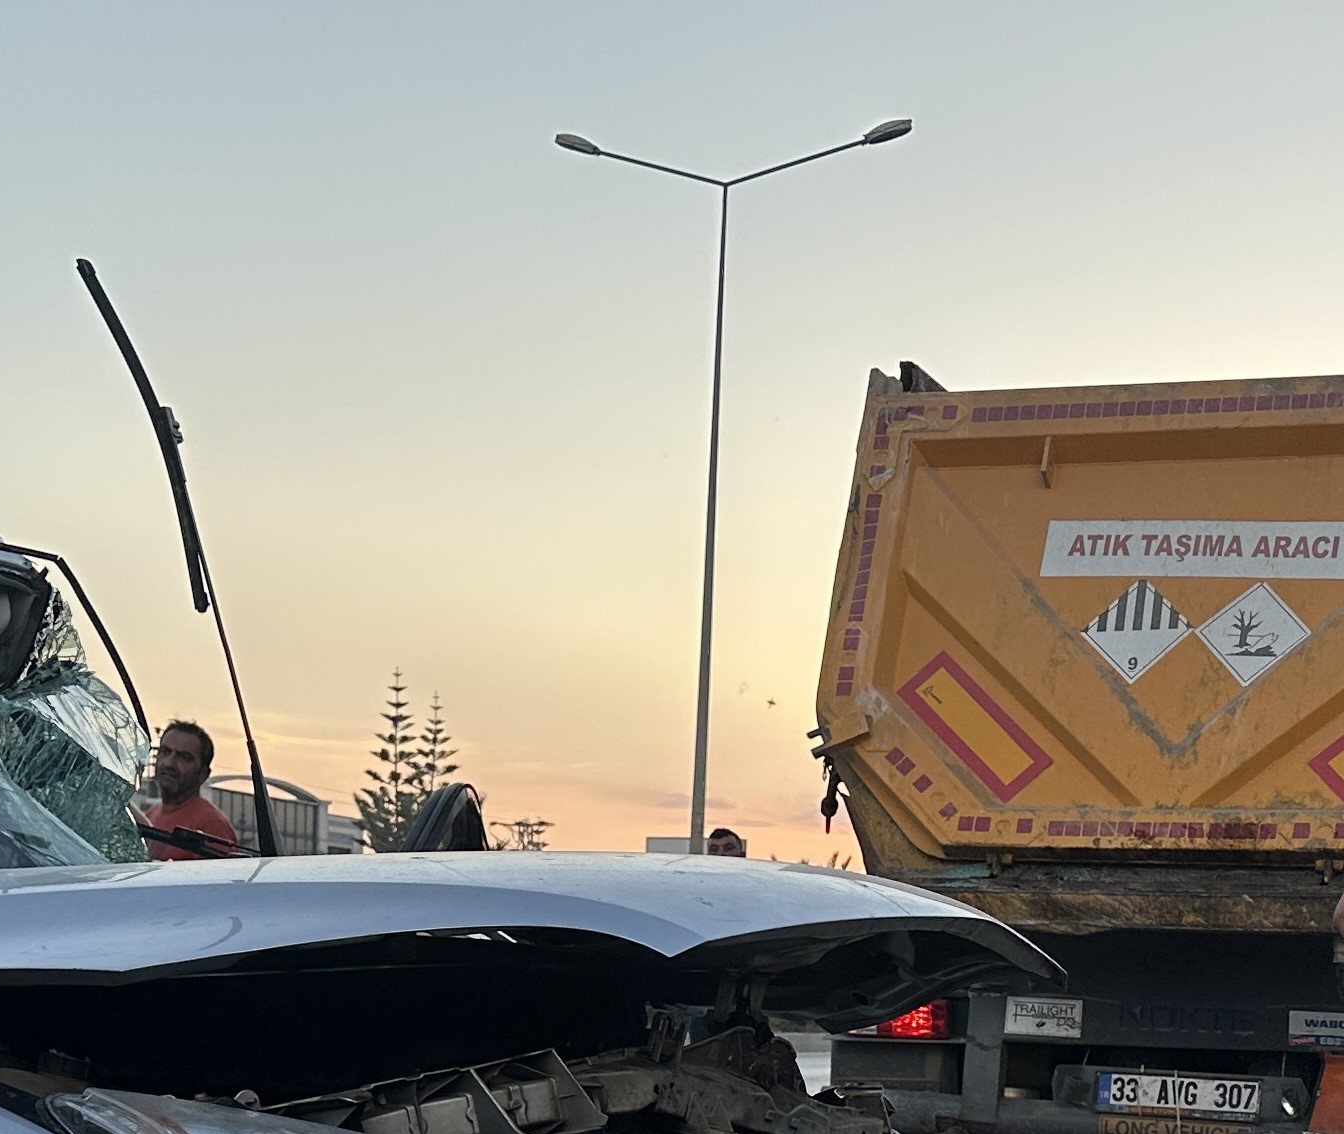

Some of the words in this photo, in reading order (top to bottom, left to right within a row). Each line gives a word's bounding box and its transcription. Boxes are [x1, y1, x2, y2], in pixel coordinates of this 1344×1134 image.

[1067, 534, 1134, 557] ATIK
[1141, 534, 1244, 562] TAŞIMA
[1252, 536, 1341, 559] ARACI
[1127, 657, 1138, 671] 9
[1112, 1077, 1138, 1102] 33
[1156, 1079, 1199, 1106] AVG
[1214, 1083, 1257, 1110] 307
